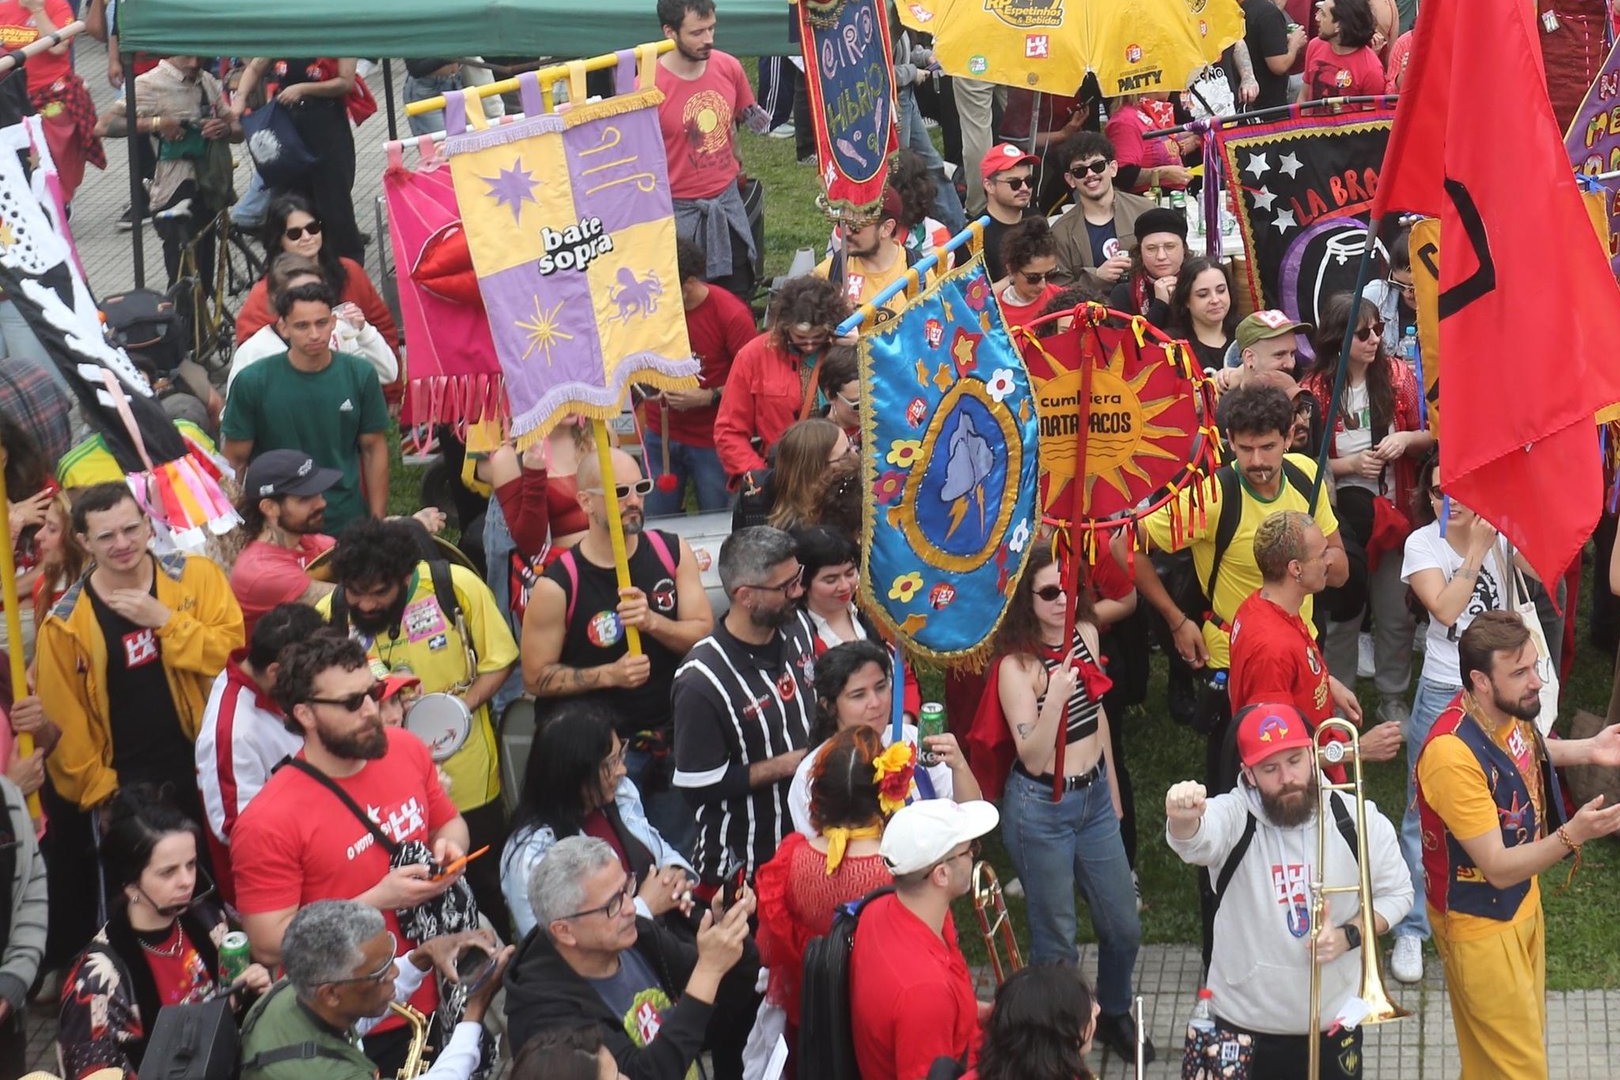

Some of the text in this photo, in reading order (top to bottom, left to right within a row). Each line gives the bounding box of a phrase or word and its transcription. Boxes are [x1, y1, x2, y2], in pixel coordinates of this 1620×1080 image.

[1004, 5, 1062, 18] Espetinhos
[1015, 15, 1061, 25] & Bebidas
[1117, 70, 1162, 93] PATTY
[1290, 167, 1381, 226] LA BRA
[541, 216, 604, 253] bate
[539, 231, 614, 276] sopra
[126, 628, 153, 651] LU
[597, 619, 618, 642] 13
[127, 642, 156, 666] LA
[388, 796, 418, 828] LU
[390, 810, 424, 842] LA
[347, 832, 374, 860] O VOTO
